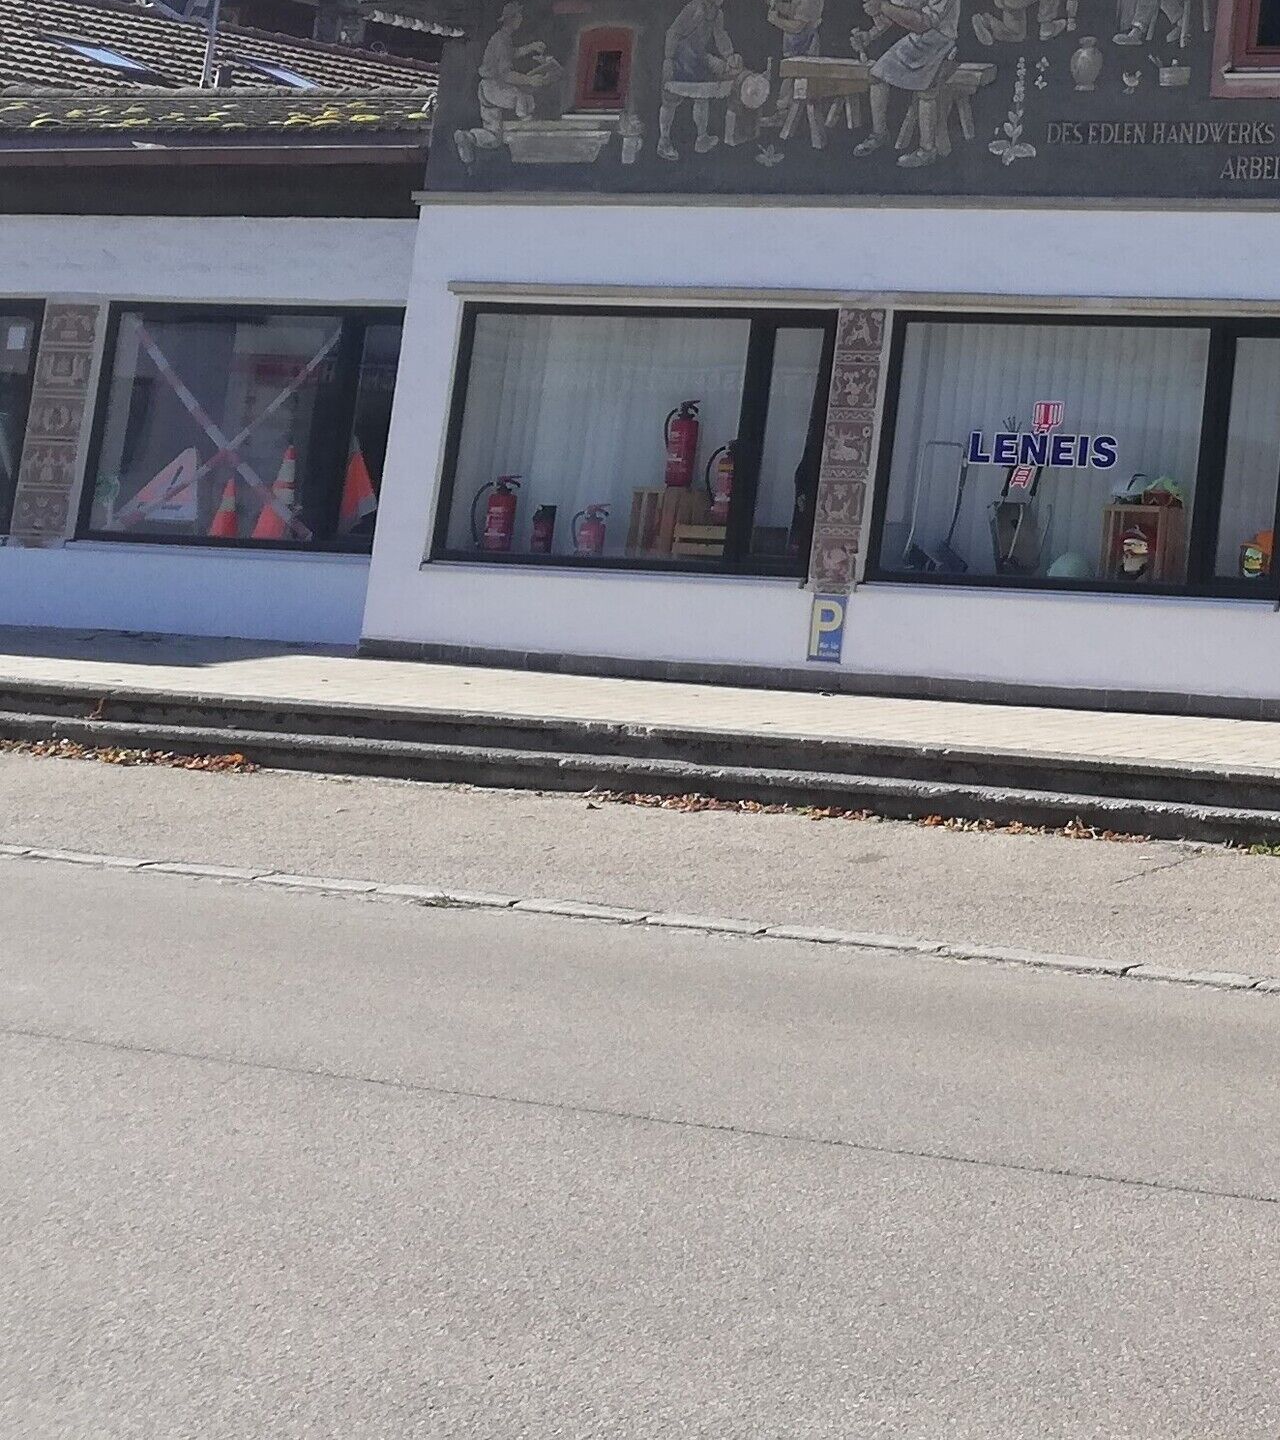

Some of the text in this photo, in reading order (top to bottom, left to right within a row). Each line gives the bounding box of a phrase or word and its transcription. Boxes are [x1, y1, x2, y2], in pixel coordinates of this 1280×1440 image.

[1047, 121, 1275, 144] DES EDLEN HANDWERKS
[968, 431, 1118, 470] LENEIS
[809, 599, 843, 656] P
